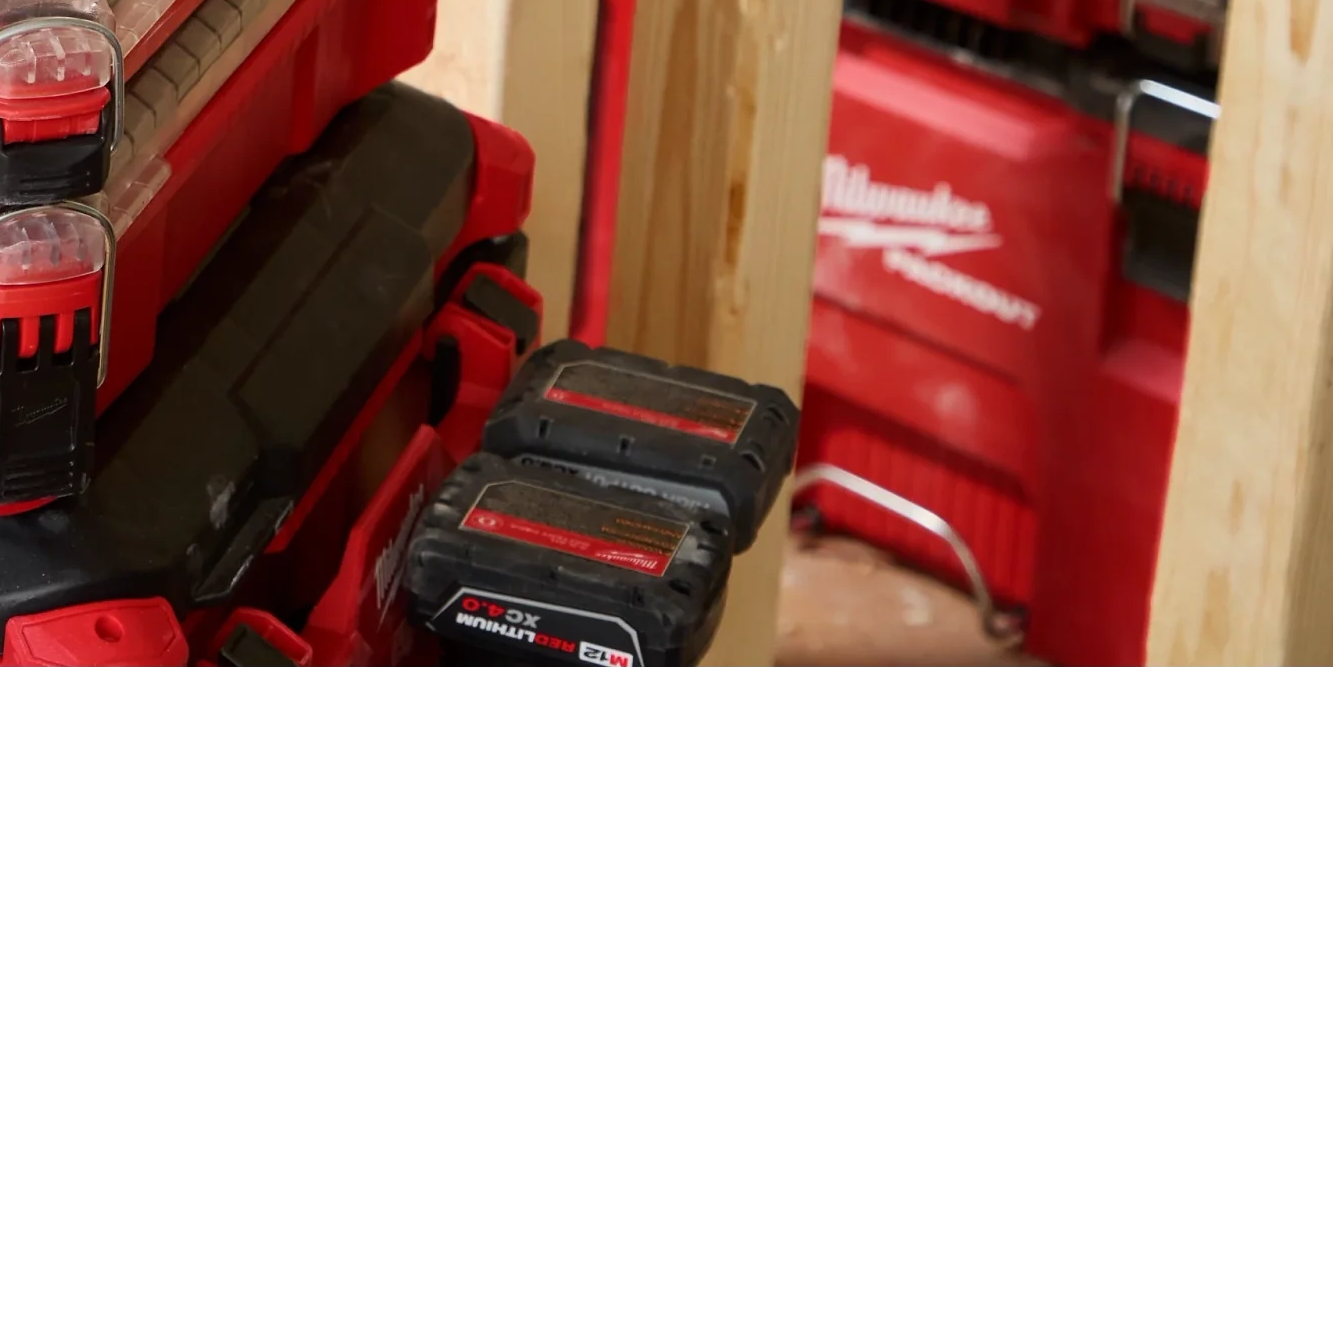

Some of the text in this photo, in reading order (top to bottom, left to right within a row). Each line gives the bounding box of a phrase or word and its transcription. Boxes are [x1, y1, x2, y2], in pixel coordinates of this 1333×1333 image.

[461, 596, 541, 629] XC4.0
[455, 612, 629, 668] M12 REDLITHIUM
